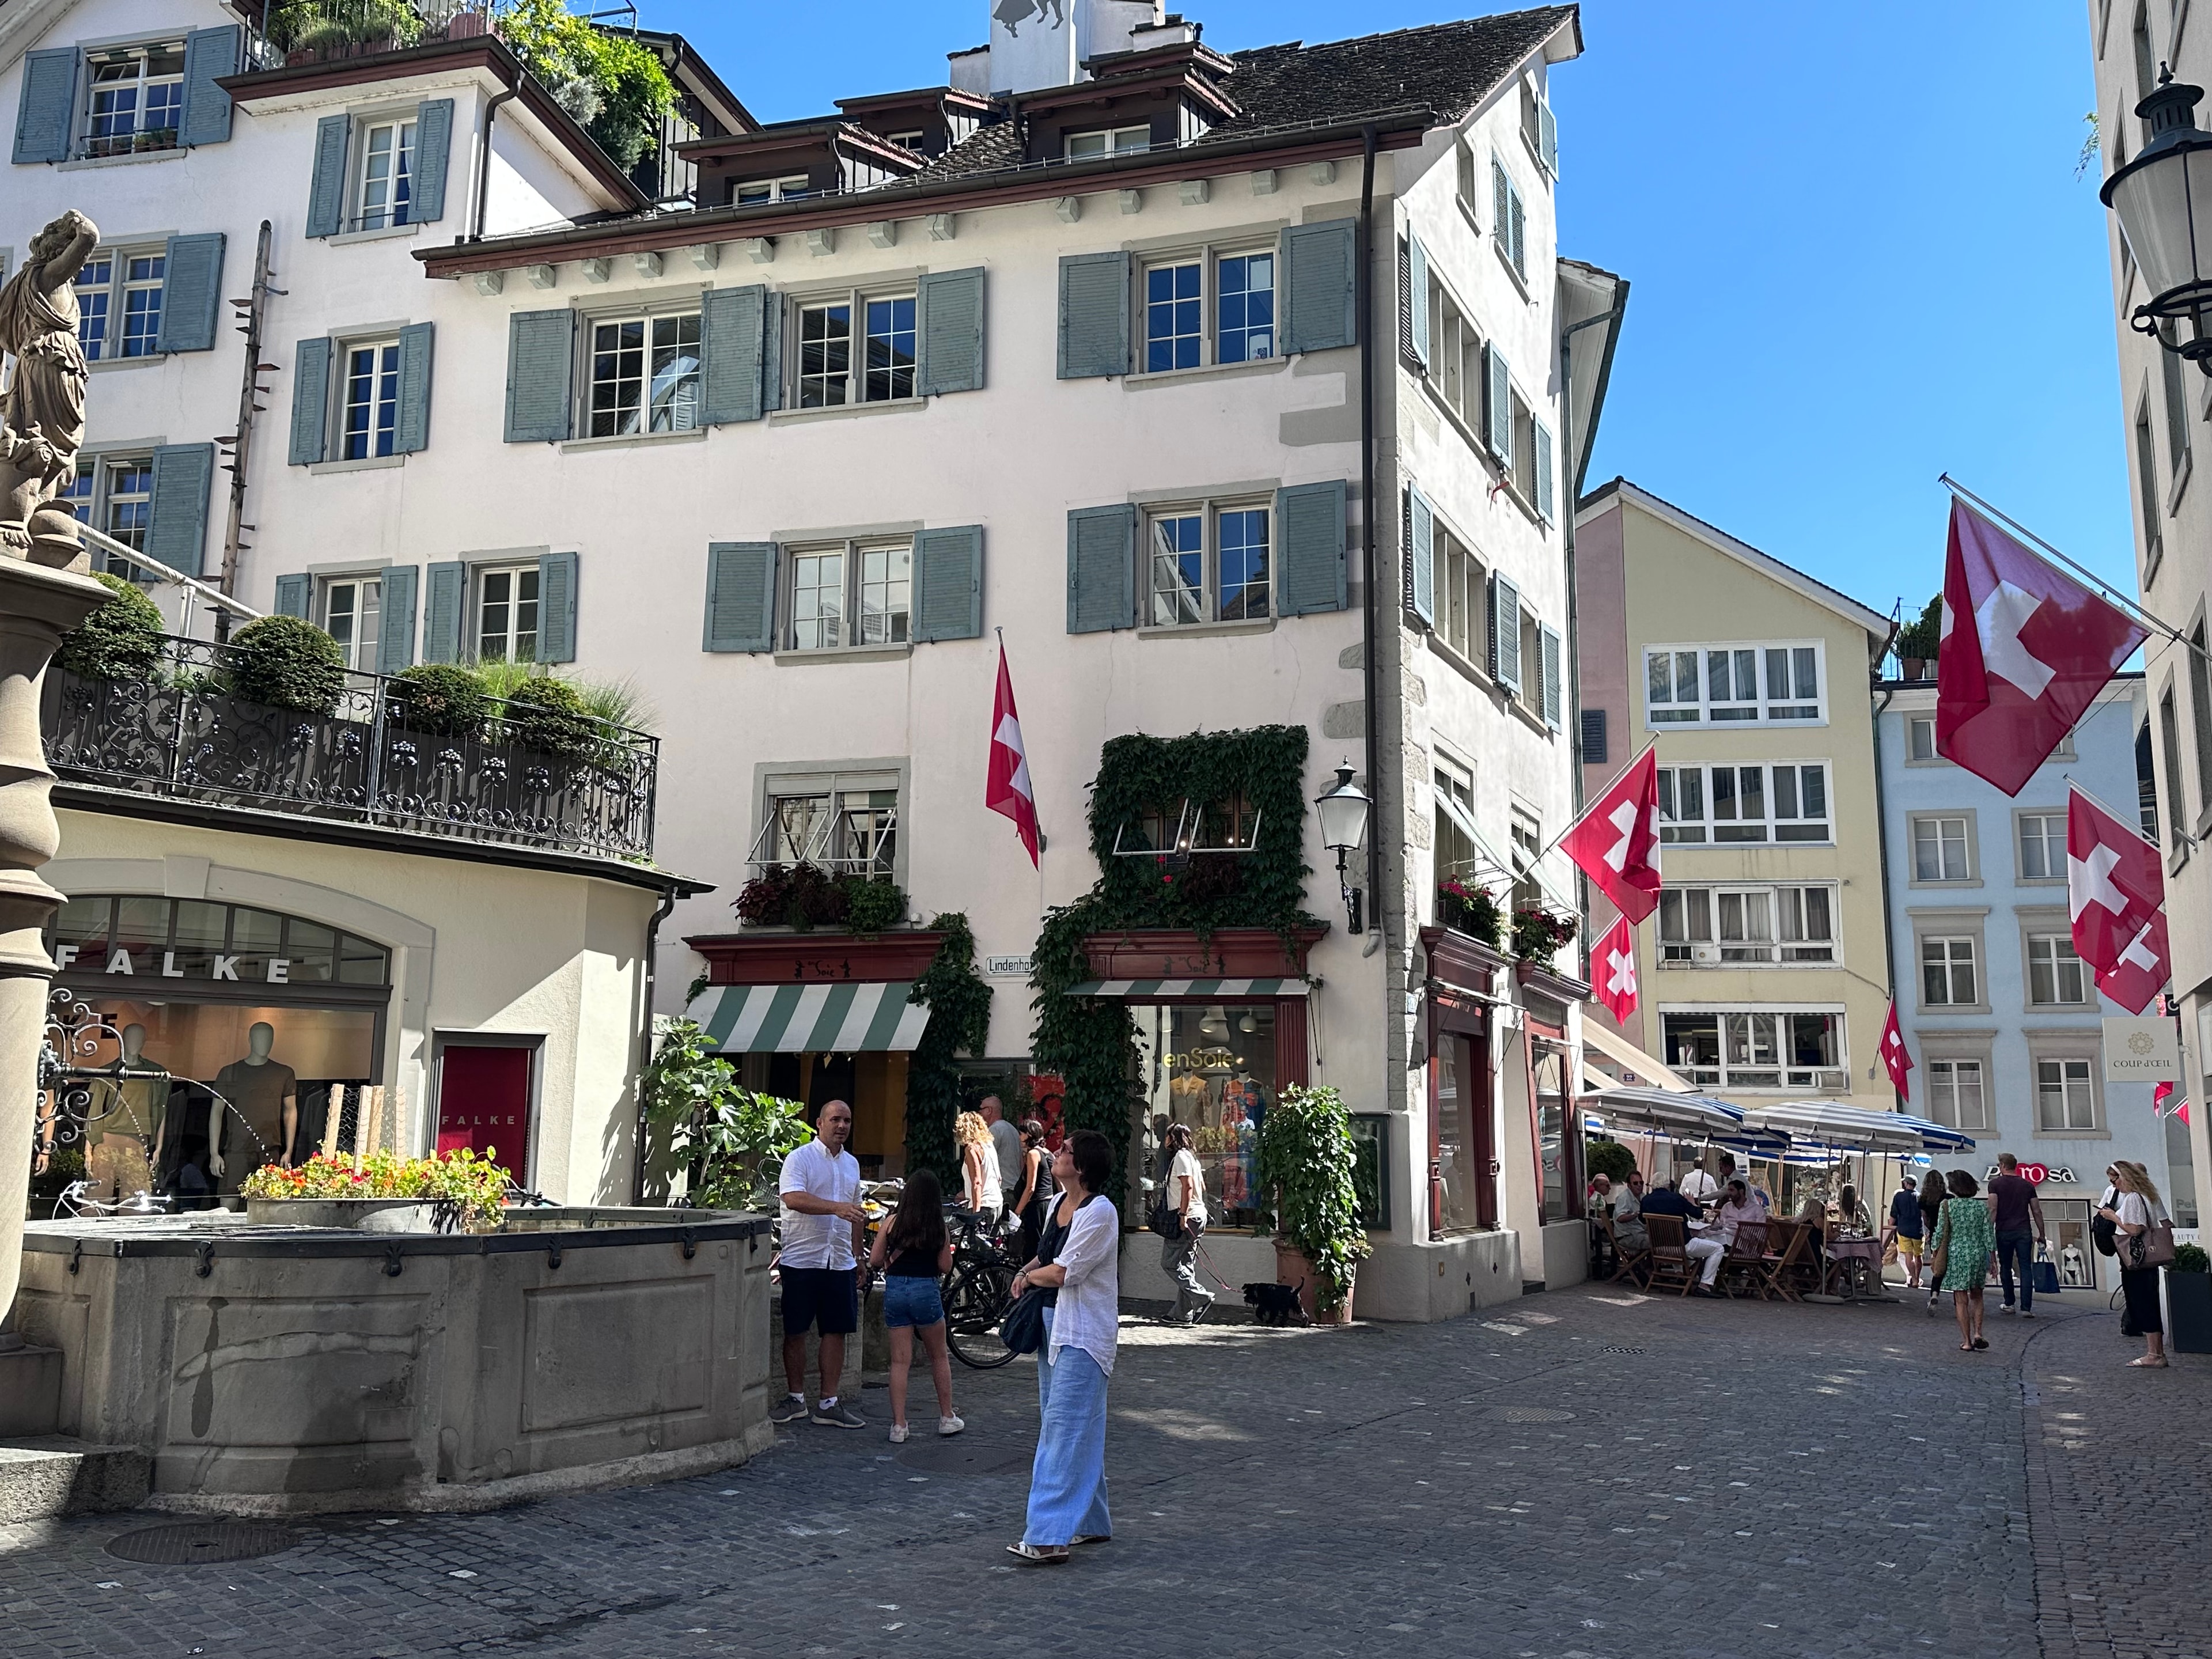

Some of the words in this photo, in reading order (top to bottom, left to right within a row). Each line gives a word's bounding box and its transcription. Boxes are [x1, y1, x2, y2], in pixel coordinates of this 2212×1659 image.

[56, 945, 290, 984] FALKE
[815, 960, 835, 978] Soie
[1163, 1047, 1236, 1068] enSoie
[2113, 1060, 2142, 1068] COUP
[441, 1115, 514, 1125] FALKE
[1982, 1165, 2079, 1183] Prosa
